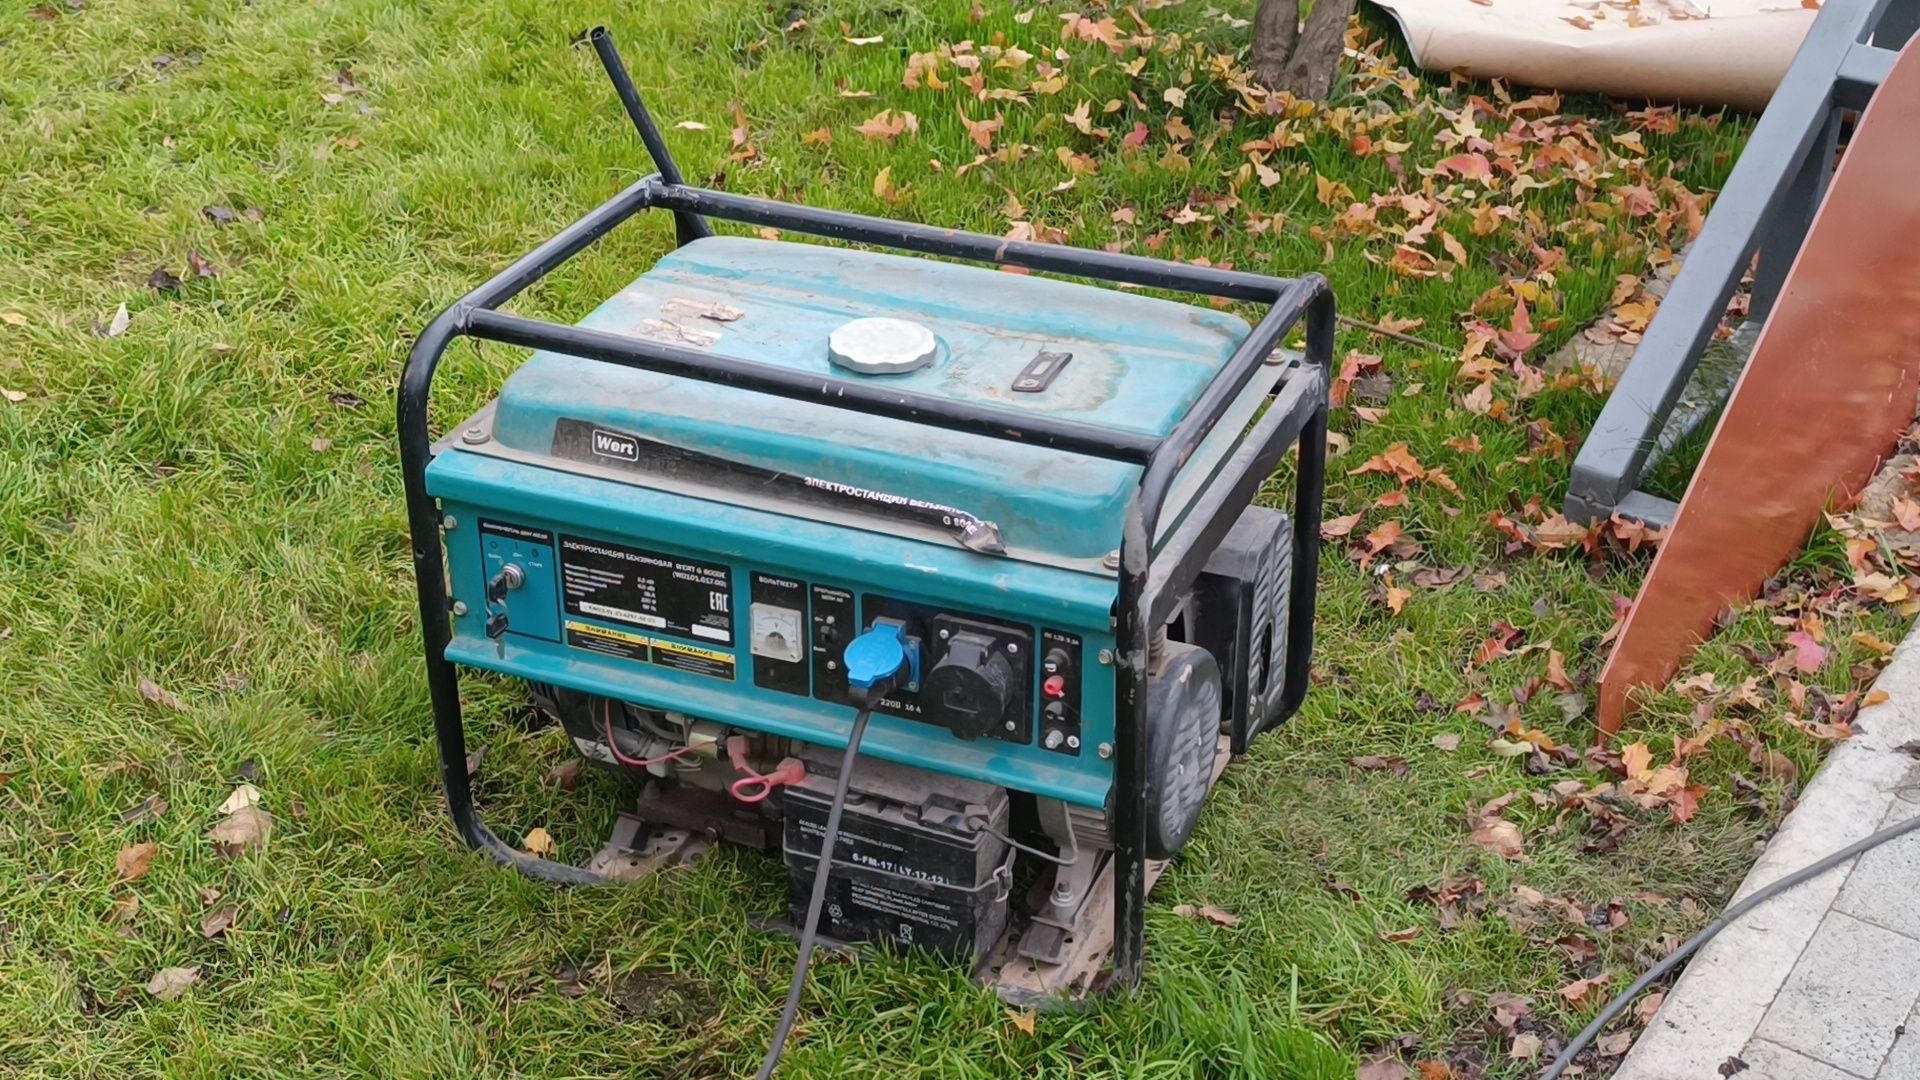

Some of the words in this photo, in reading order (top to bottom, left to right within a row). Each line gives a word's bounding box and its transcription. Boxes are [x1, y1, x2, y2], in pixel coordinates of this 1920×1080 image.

[597, 435, 634, 455] Wert
[943, 516, 951, 525] G
[852, 852, 893, 870] 6-FM-17
